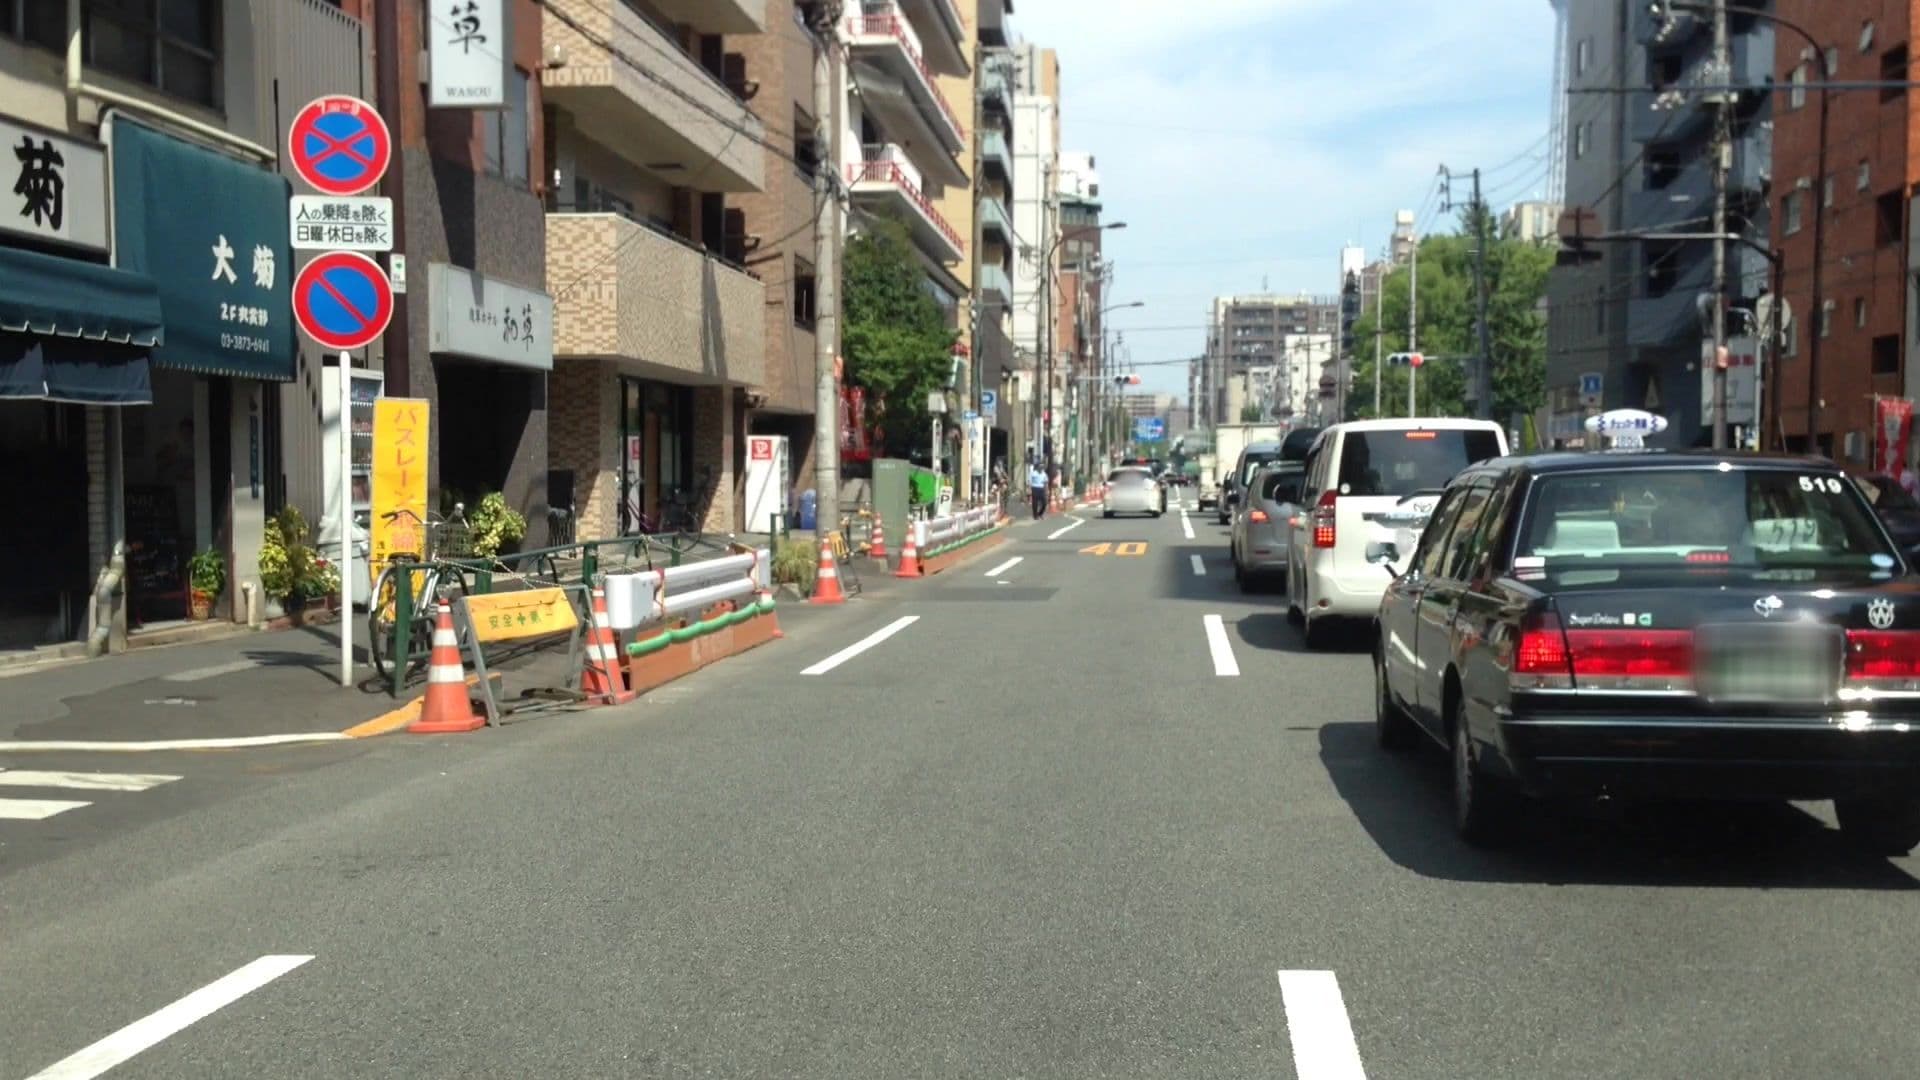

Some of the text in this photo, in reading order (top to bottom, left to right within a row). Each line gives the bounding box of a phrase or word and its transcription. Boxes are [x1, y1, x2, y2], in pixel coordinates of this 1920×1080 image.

[448, 1, 487, 54] 草
[13, 135, 64, 230] 菊
[296, 203, 387, 222] 人の乗降を除く
[1798, 476, 1843, 494] 519
[1078, 542, 1148, 556] 40
